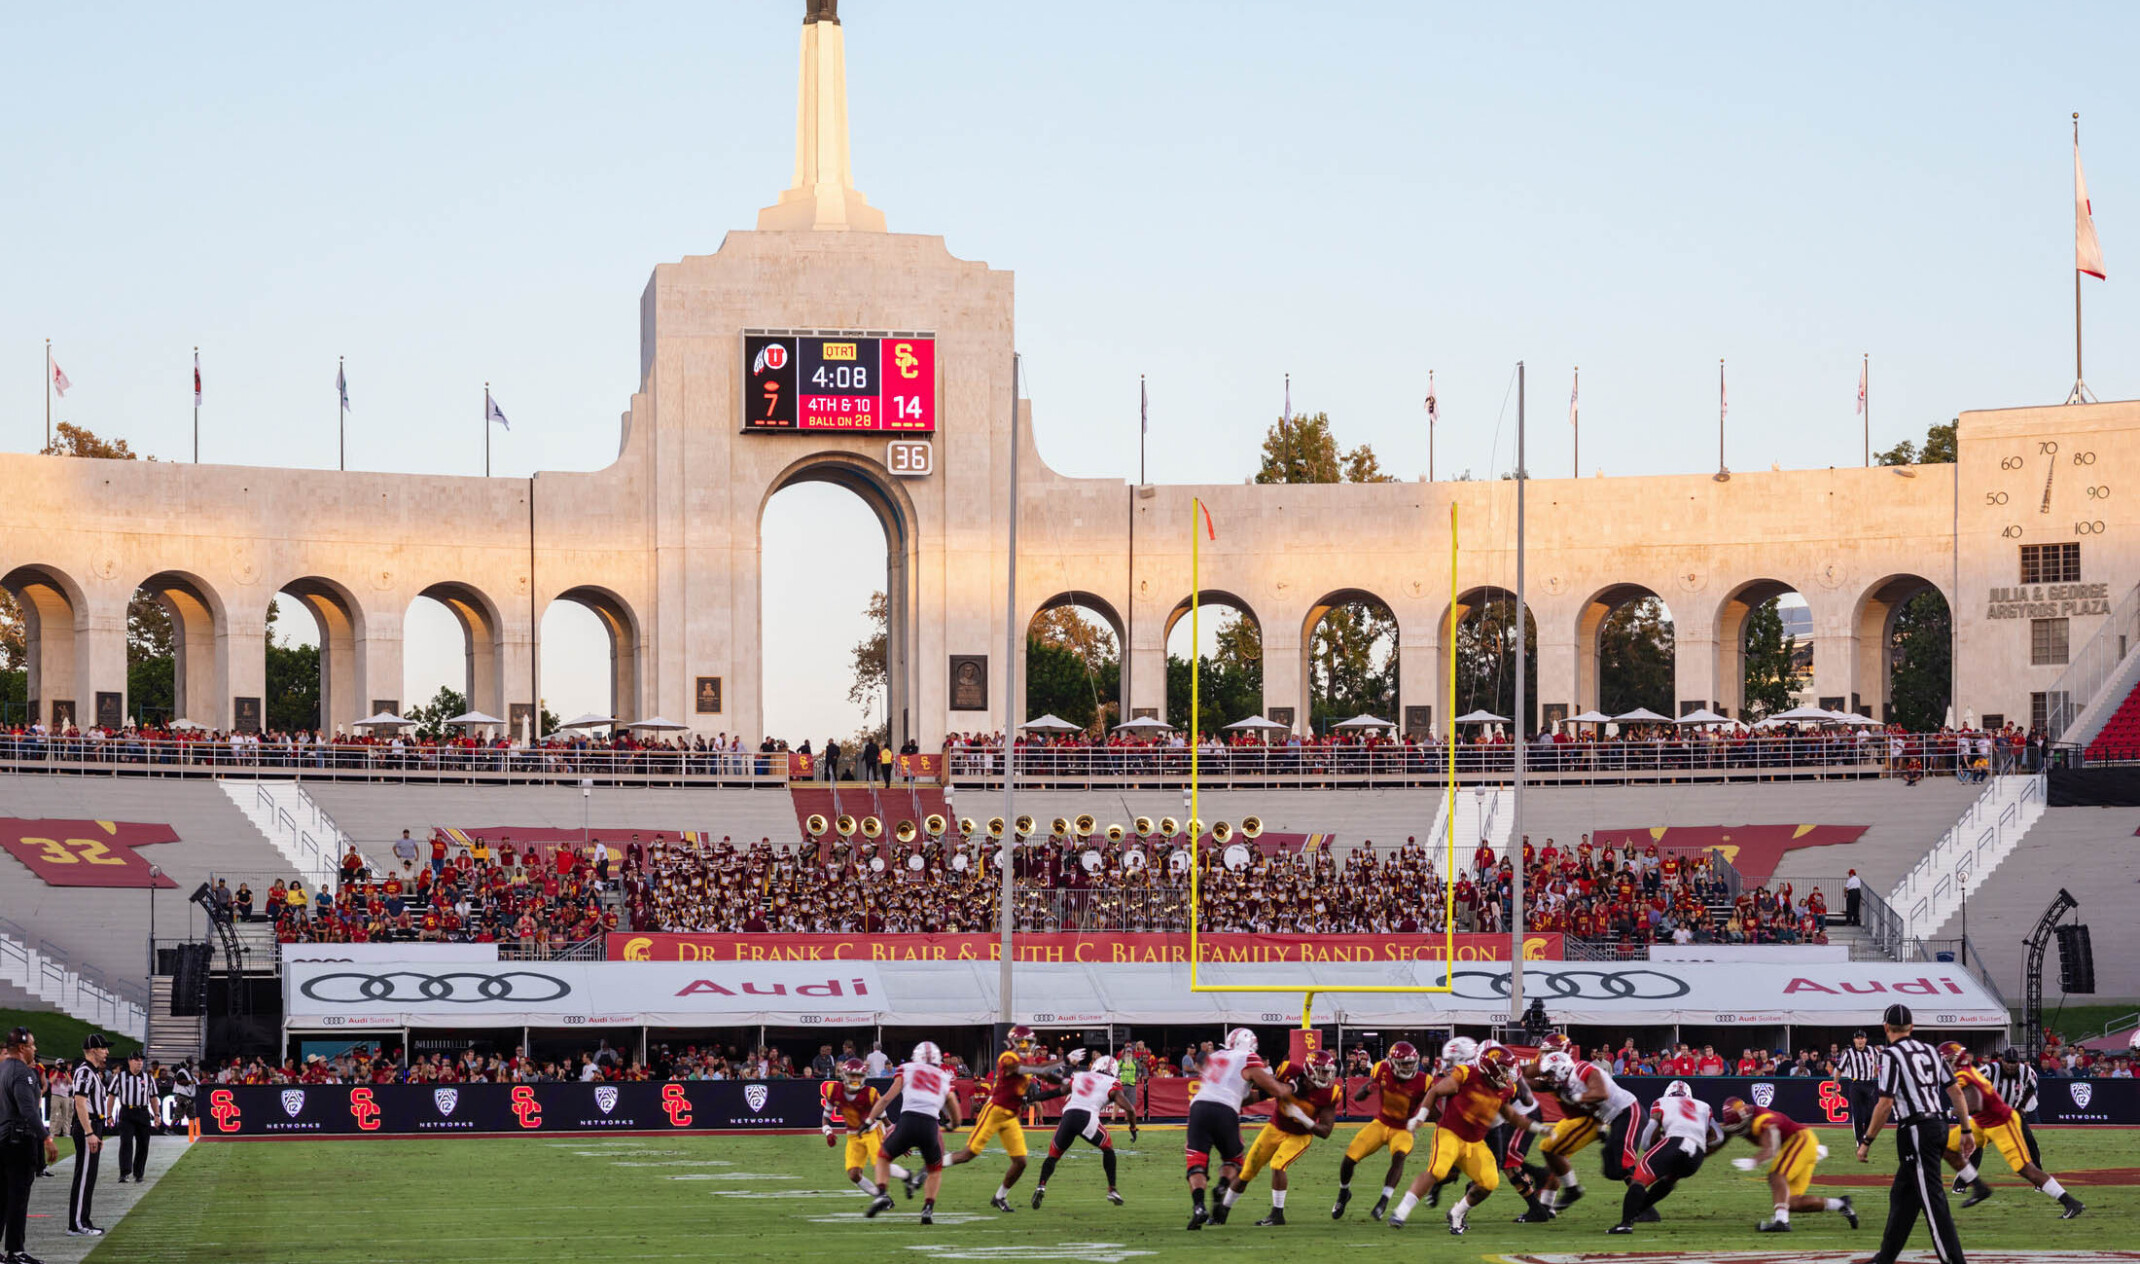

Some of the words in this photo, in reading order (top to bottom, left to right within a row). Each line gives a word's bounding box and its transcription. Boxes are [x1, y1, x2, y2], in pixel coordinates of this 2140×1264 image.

[766, 348, 784, 366] U
[826, 345, 854, 357] QTR1
[895, 343, 918, 378] SC
[812, 366, 867, 388] 4:08
[764, 394, 778, 417] 7
[808, 398, 836, 412] 4TH
[841, 398, 852, 412] &
[855, 398, 870, 412] 10
[893, 396, 922, 419] 14
[809, 416, 835, 426] BALL
[837, 416, 852, 426] ON
[855, 414, 871, 426] 28
[897, 446, 925, 469] 36
[2038, 441, 2058, 456] 70
[2001, 456, 2023, 470] 60
[2073, 451, 2096, 466] 80
[1986, 491, 2009, 506] 50
[2086, 485, 2110, 500] 90
[2001, 525, 2022, 539] 40
[2075, 520, 2105, 535] 100
[2033, 586, 2044, 601] &
[2048, 583, 2109, 600] GEORGE
[1986, 603, 2058, 620] ARGYROS
[2062, 599, 2111, 616] PLAZA
[19, 837, 127, 865] 32
[734, 942, 825, 962] FRANK
[957, 942, 977, 961] &
[1300, 942, 1374, 962] BAND
[1385, 942, 1497, 962] SECTON
[674, 978, 868, 997] Audi
[1782, 977, 1964, 995] Audi
[1305, 1033, 1315, 1049] SC
[1912, 1053, 1933, 1084] C
[288, 1104, 298, 1112] 12
[351, 1087, 381, 1131] SC
[442, 1103, 452, 1111] 12
[511, 1085, 542, 1129] SC
[602, 1101, 612, 1109] 12
[662, 1083, 692, 1127] SC
[752, 1100, 761, 1108] 12
[1819, 1081, 1849, 1122] SC
[2078, 1096, 2087, 1104] 12
[210, 1089, 241, 1132] SC
